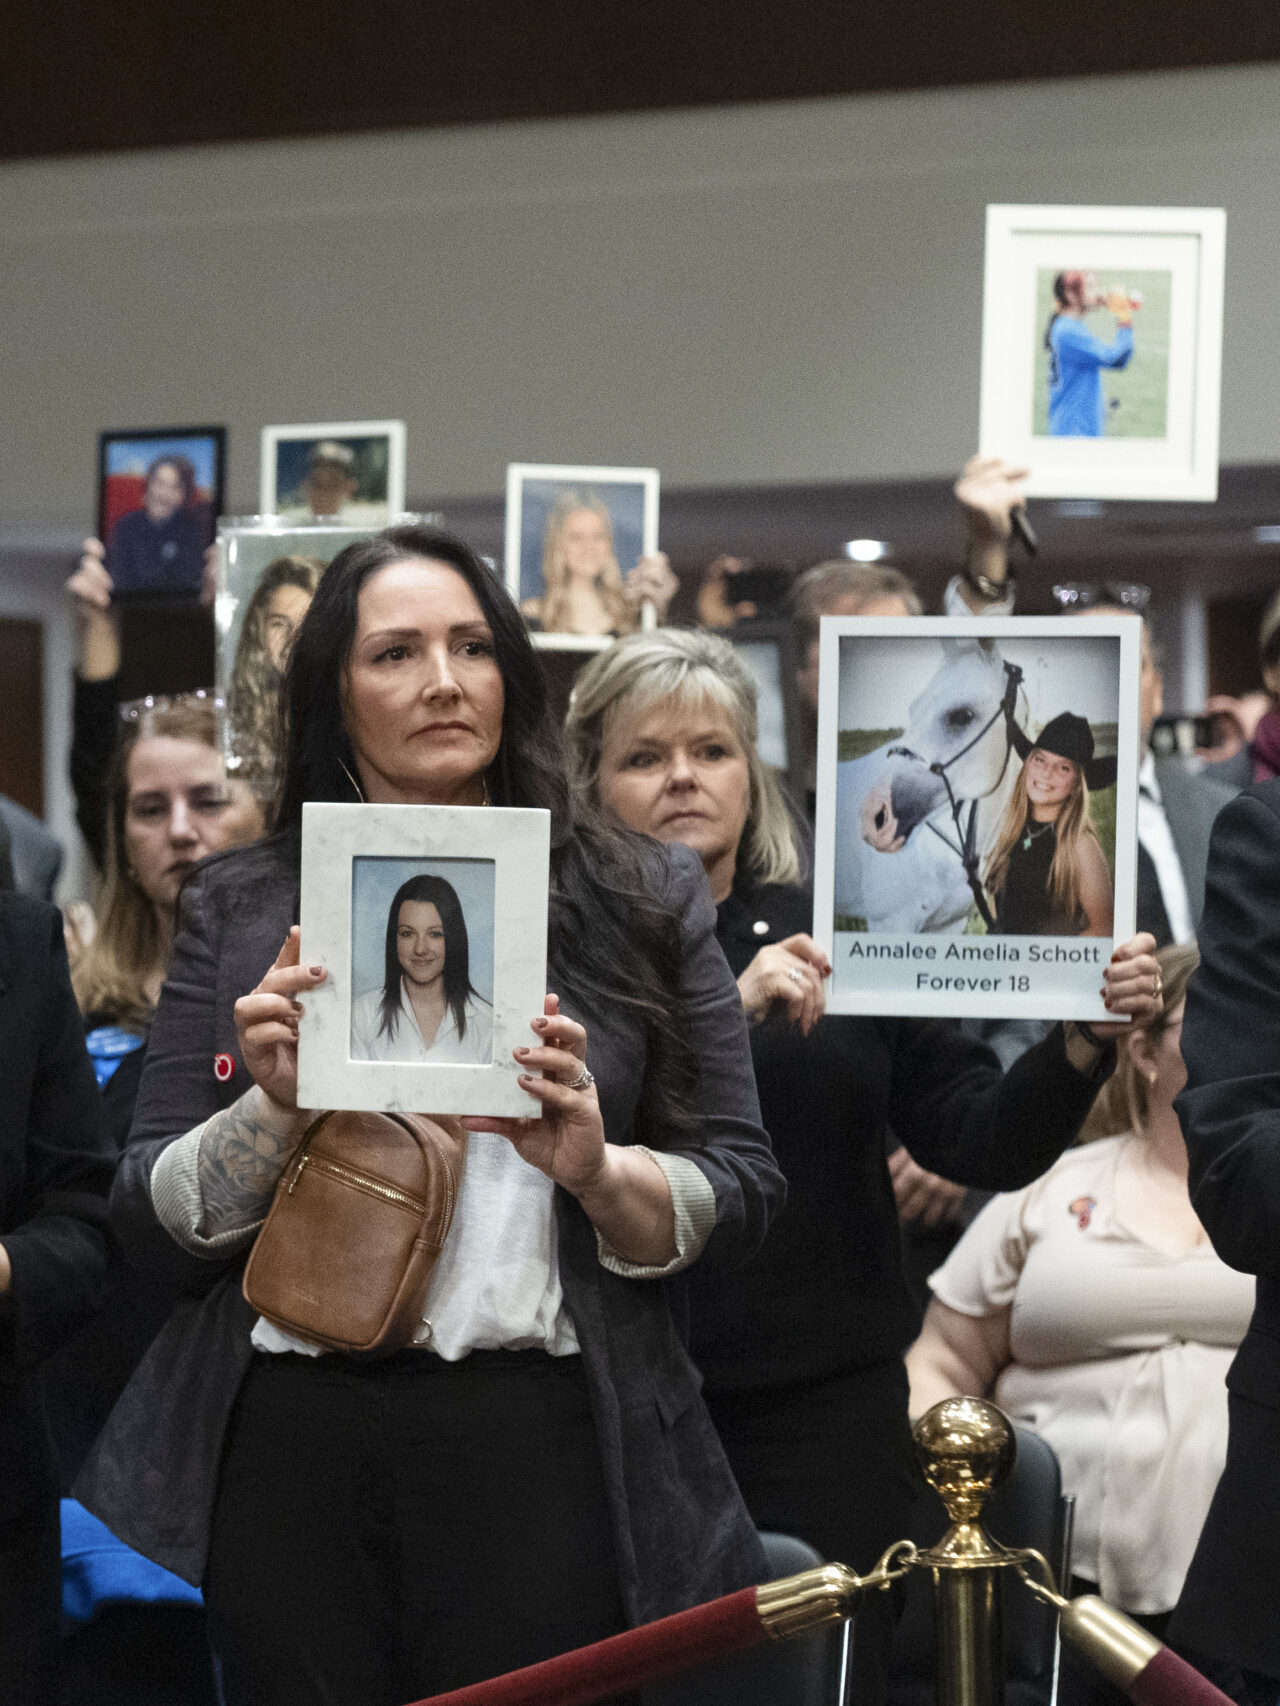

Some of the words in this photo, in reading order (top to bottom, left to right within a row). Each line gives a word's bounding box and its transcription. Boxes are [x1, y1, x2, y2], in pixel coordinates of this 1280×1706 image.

[848, 940, 937, 960] Annalee
[945, 942, 1020, 962] Amelia
[1028, 944, 1101, 964] Schott
[916, 972, 1002, 991] Forever
[1009, 975, 1030, 992] 18
